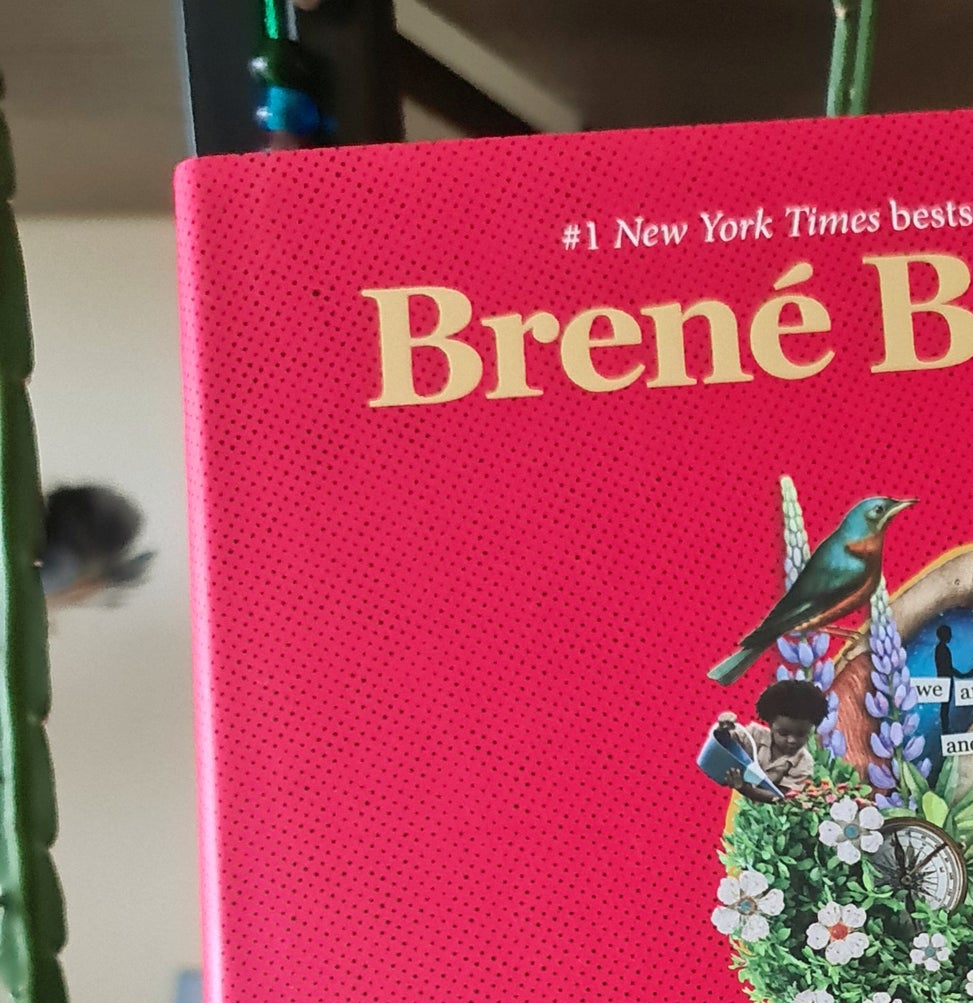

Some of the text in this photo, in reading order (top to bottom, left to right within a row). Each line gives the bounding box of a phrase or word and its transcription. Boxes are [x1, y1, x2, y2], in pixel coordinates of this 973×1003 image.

[560, 222, 600, 252] #1
[613, 215, 688, 249] New
[700, 207, 772, 244] York
[783, 202, 882, 240] Times
[361, 262, 835, 408] Brené
[916, 683, 943, 697] we
